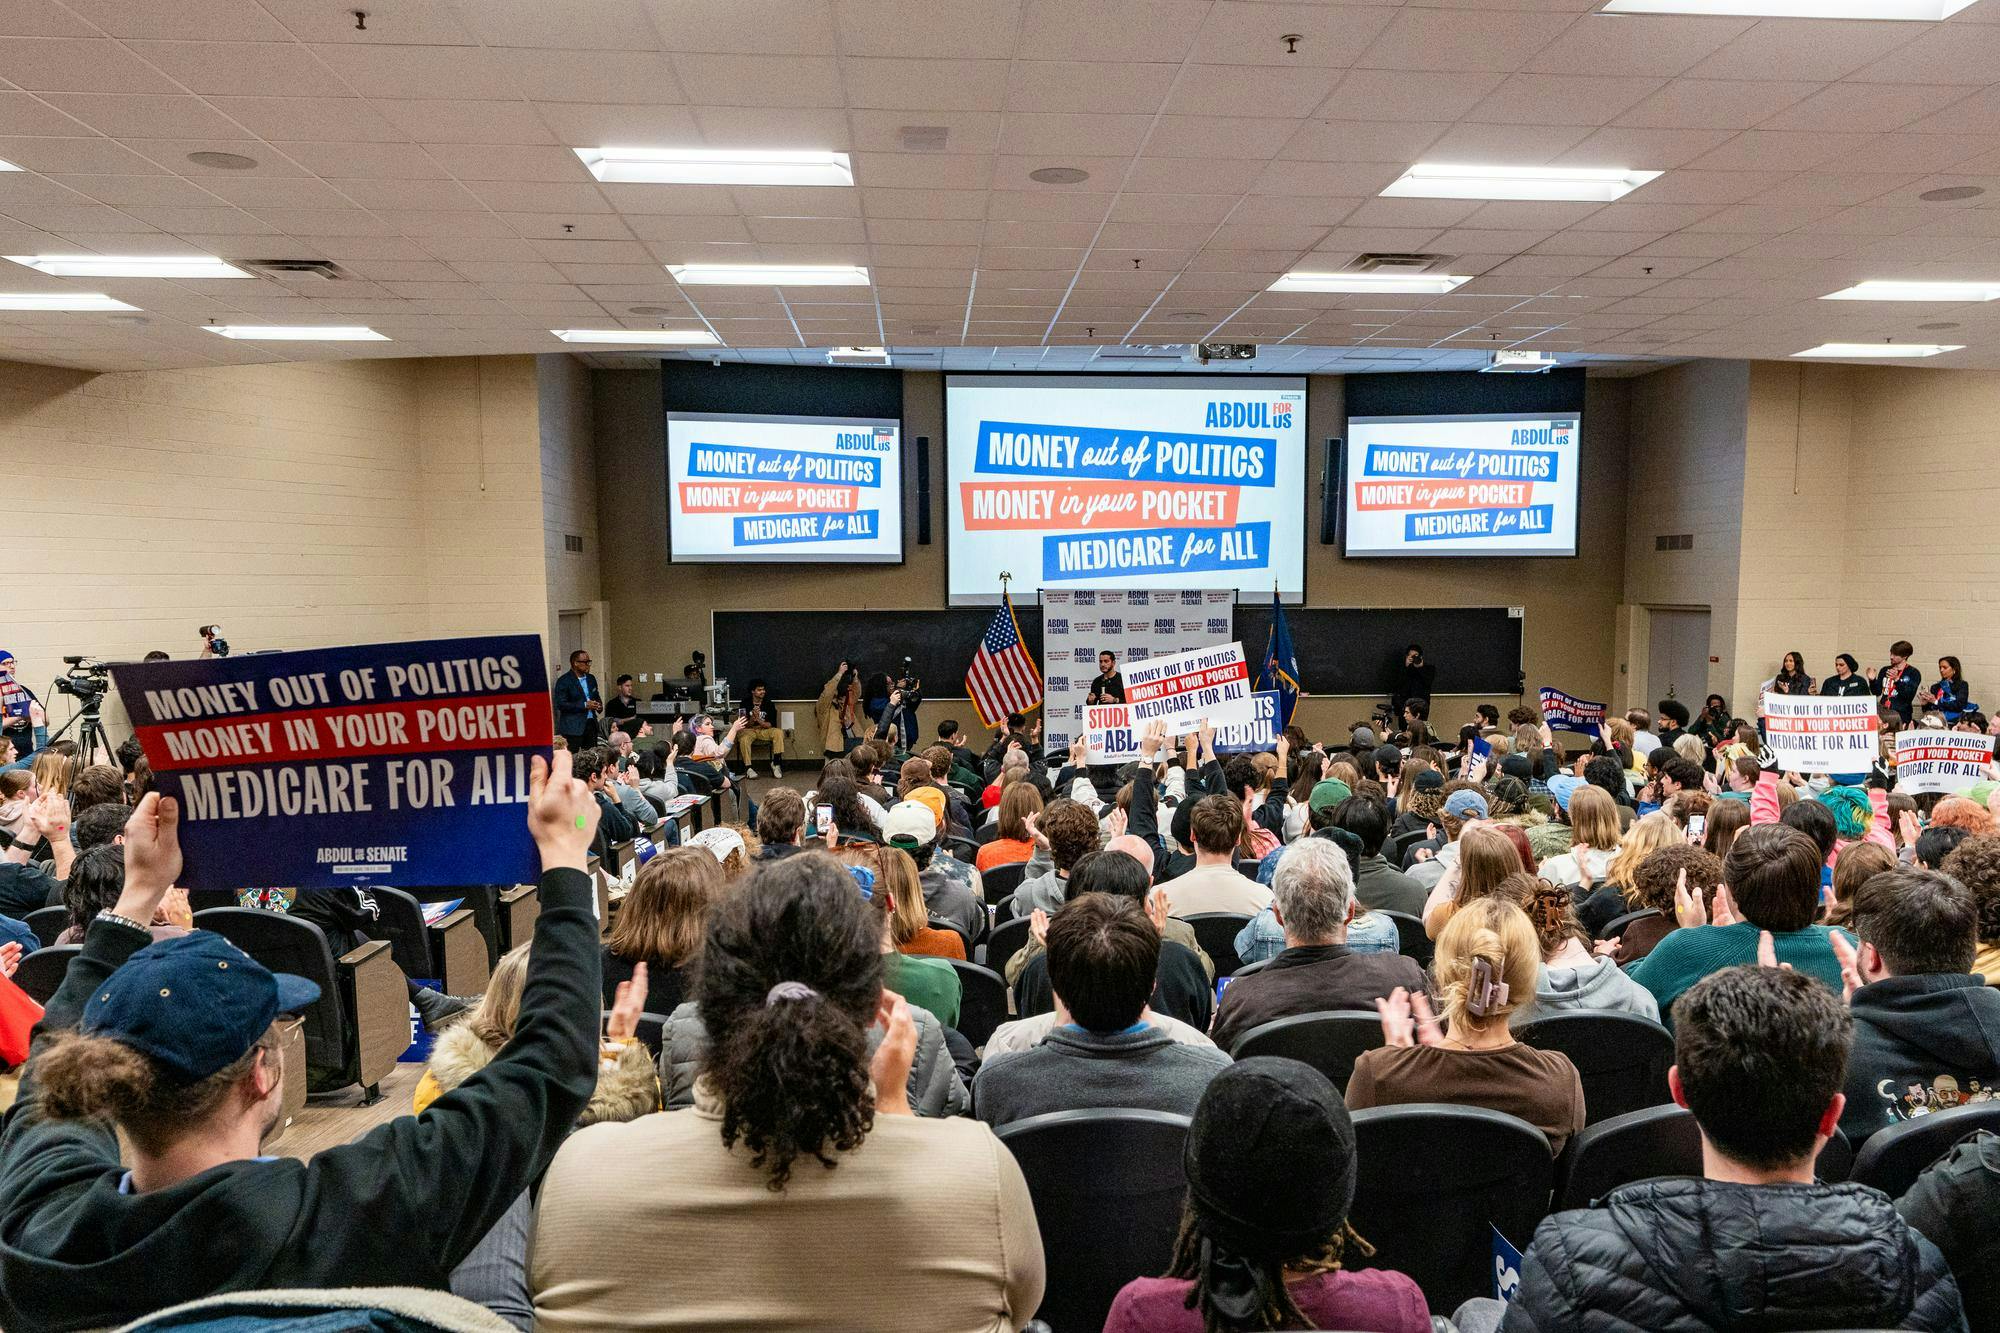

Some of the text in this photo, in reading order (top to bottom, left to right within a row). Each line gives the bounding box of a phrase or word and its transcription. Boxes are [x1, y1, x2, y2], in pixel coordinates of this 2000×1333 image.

[1205, 402, 1292, 428] ABDUL FOR US
[836, 433, 877, 450] ABDUL
[878, 441, 890, 451] US
[1511, 429, 1554, 445] ABDUL
[1556, 435, 1568, 445] US
[988, 431, 1264, 478] MONEY out of POLITICS
[696, 450, 874, 482] MONEY out of POLITICS
[1372, 451, 1550, 478] MONEY out of POLITICS
[686, 485, 851, 511] MONEY in your POCKET
[1362, 483, 1525, 508] MONEY in your POCKET
[972, 486, 1228, 525] MONEY in your POCKET
[743, 515, 872, 541] MEDICARE for ALL
[1415, 510, 1544, 536] MEDICARE for ALL
[1058, 531, 1258, 572] MEDICARE for ALL
[1074, 591, 1096, 599] ABDUL
[1127, 590, 1149, 599] ABDUL
[1181, 590, 1202, 599] ABDUL
[1047, 619, 1069, 628] ABDUL
[1101, 619, 1122, 628] ABDUL
[1154, 619, 1176, 628] ABDUL
[1207, 619, 1228, 627] ABDUL
[1074, 647, 1096, 656] ABDUL
[1127, 647, 1149, 656] ABDUL
[1129, 650, 1236, 685] MONEY OUT OF POLITICS
[145, 655, 522, 721] MONEY OUT OF POLITICS
[1047, 677, 1069, 685] ABDUL
[1131, 666, 1240, 700] MONEY IN YOUR POCKET
[1135, 683, 1243, 720] MEDICARE FOR ALL
[1552, 693, 1563, 702] OUT
[1573, 701, 1601, 710] POLITICS
[1560, 703, 1575, 714] YOUR
[1769, 703, 1868, 715] MONEY OUT OF POLITICS
[1089, 707, 1131, 729] STUDE
[1568, 714, 1583, 724] FOR
[1586, 716, 1599, 724] ALL
[1769, 717, 1868, 731] MONEY IN YOUR POCKET
[163, 702, 527, 761] MONEY IN YOUR POCKET
[1047, 734, 1069, 742] ABDUL
[1090, 734, 1103, 744] FOR
[1215, 720, 1277, 746] ABDUL
[1769, 734, 1869, 750] MEDICARE FOR ALL
[1918, 737, 1933, 746] OUT
[1936, 737, 1945, 746] OF
[1948, 738, 1986, 749] POLITICS
[1917, 749, 1925, 759] IN
[1927, 748, 1949, 759] YOUR
[1951, 749, 1985, 761] POCKET
[1938, 761, 1958, 775] FOR
[1962, 763, 1981, 777] ALL
[179, 753, 530, 821] MEDICARE FOR ALL
[316, 848, 354, 863] ABDUL
[366, 846, 408, 862] SENATE
